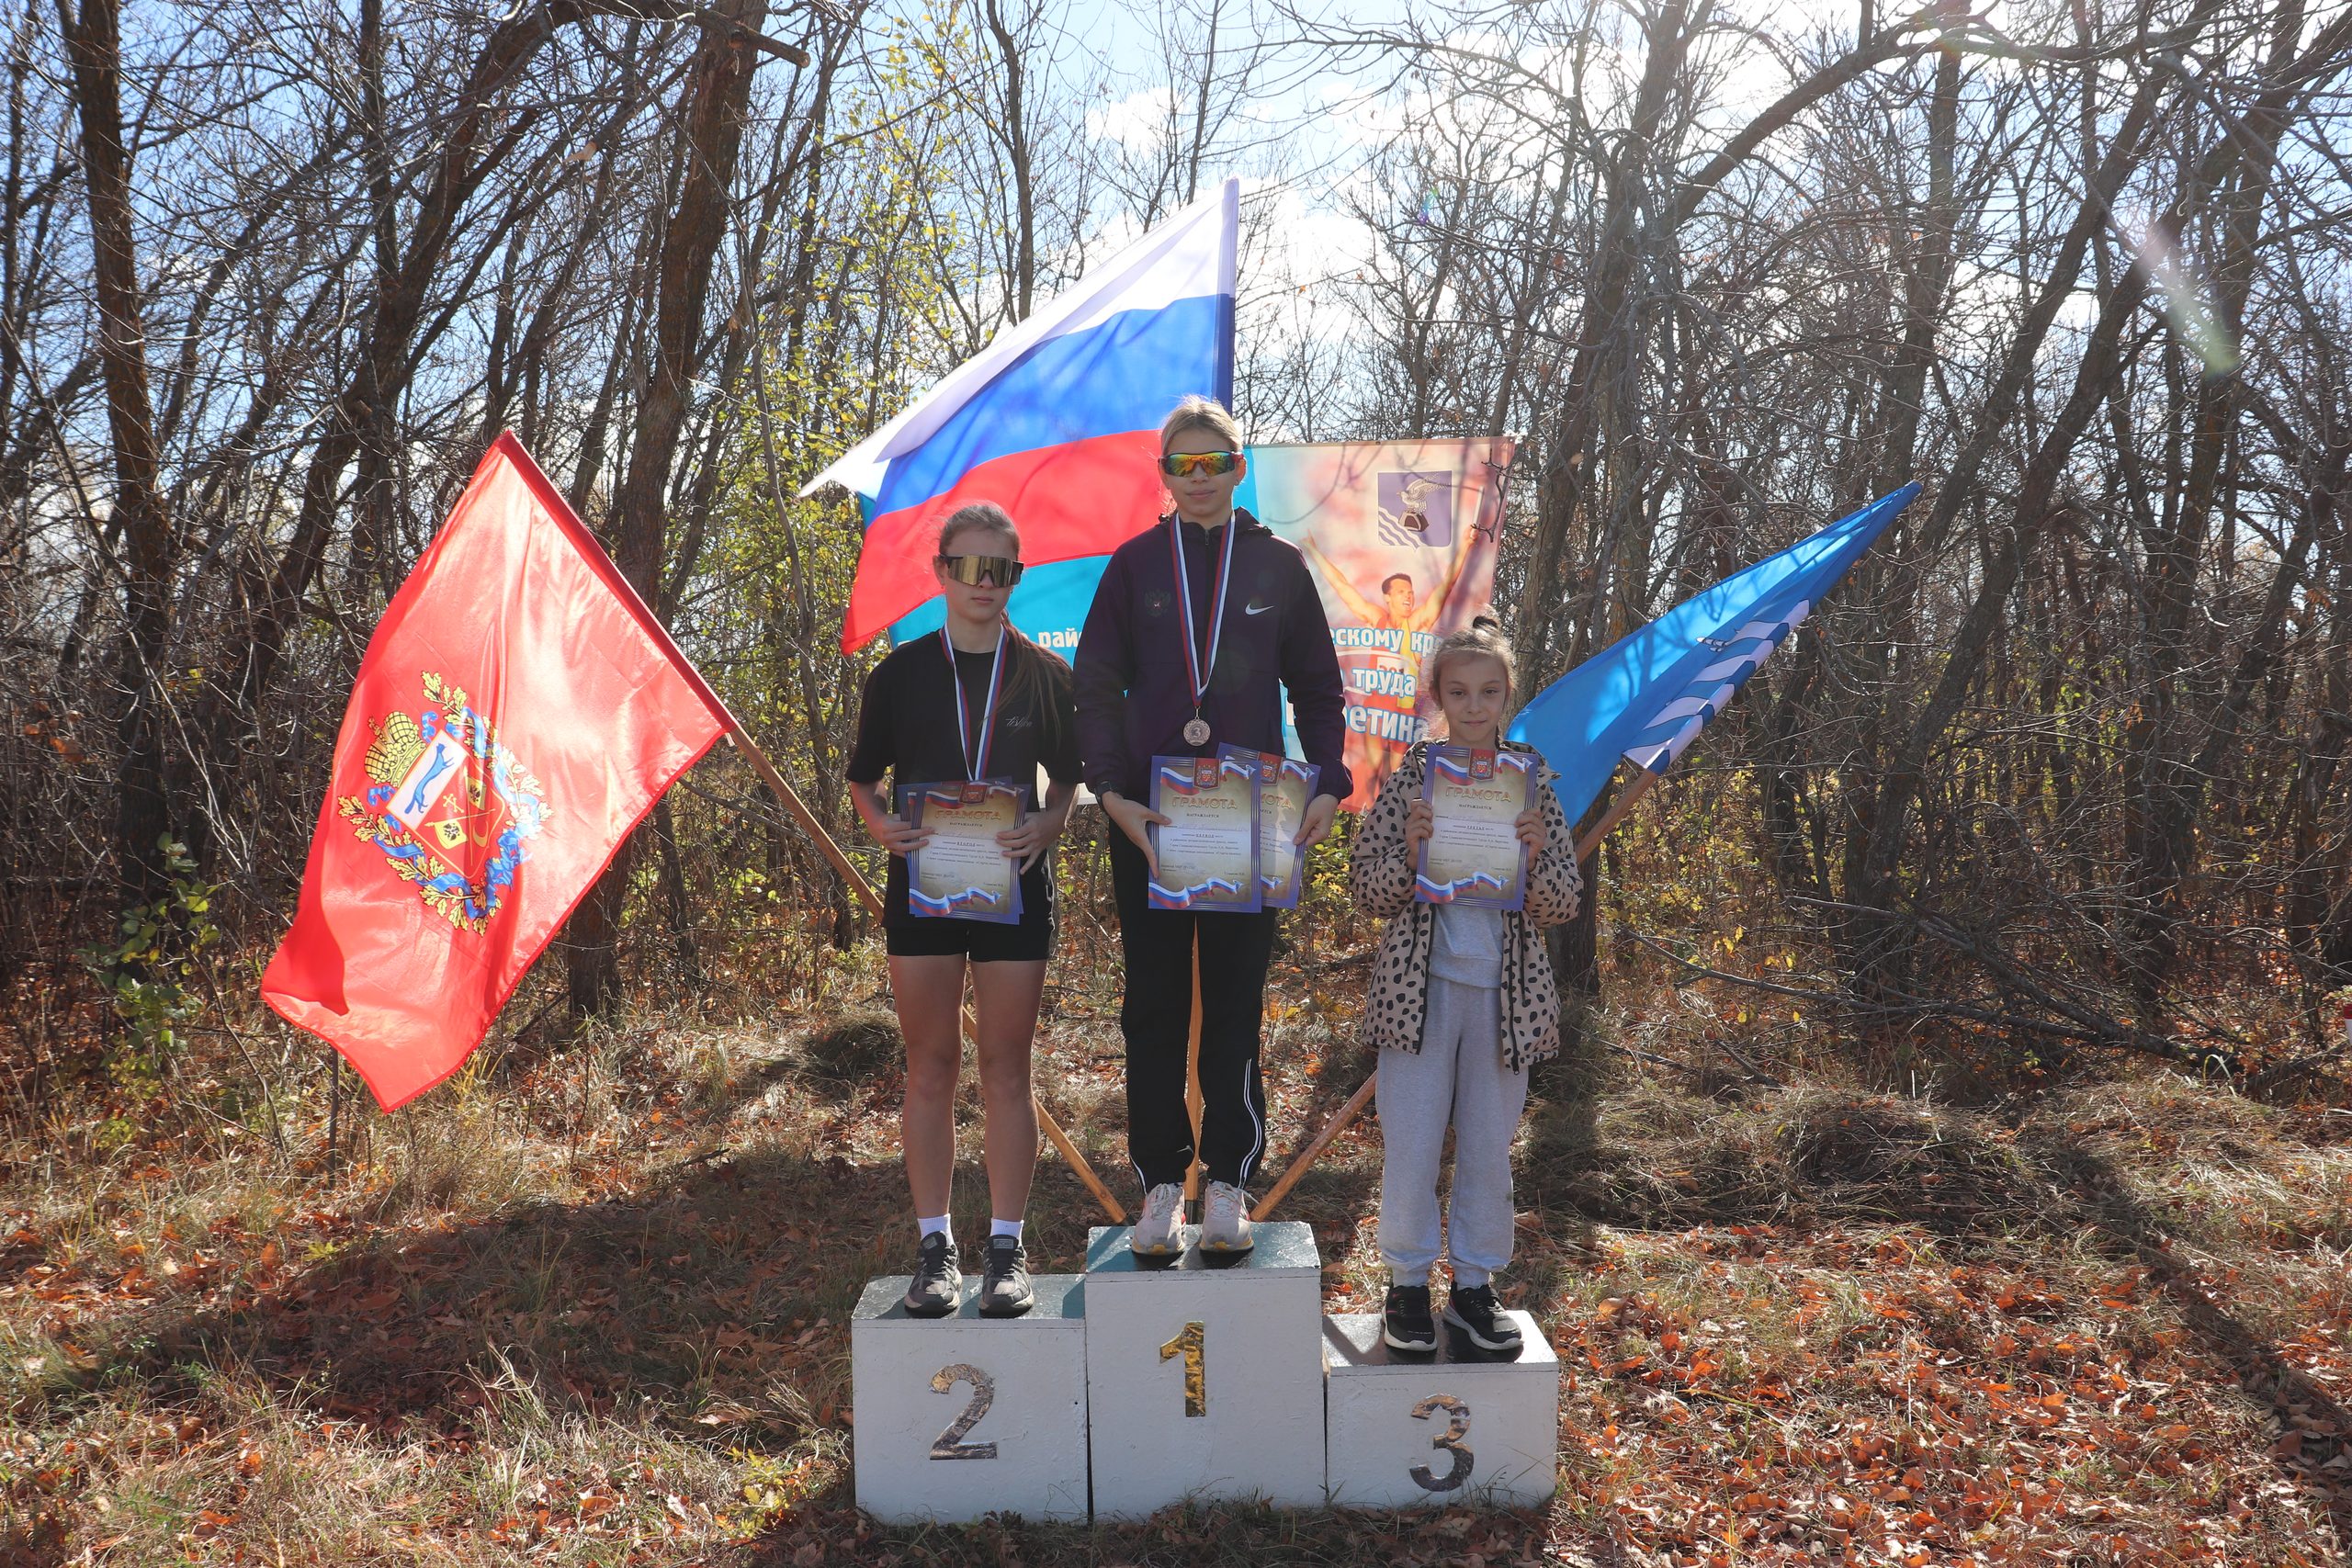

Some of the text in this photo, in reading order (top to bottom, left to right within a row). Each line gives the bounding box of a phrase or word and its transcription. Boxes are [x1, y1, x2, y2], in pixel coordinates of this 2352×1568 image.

[1038, 627, 1081, 648] рай
[1353, 669, 1416, 697] труда
[1343, 705, 1428, 744] етина
[1171, 796, 1238, 809] ГРАМОТА
[1445, 786, 1511, 803] ГРАМОТА
[934, 810, 1001, 820] ГРАМОТА
[1159, 1320, 1206, 1417] 1
[930, 1363, 998, 1461] 2
[1408, 1393, 1475, 1493] 3
